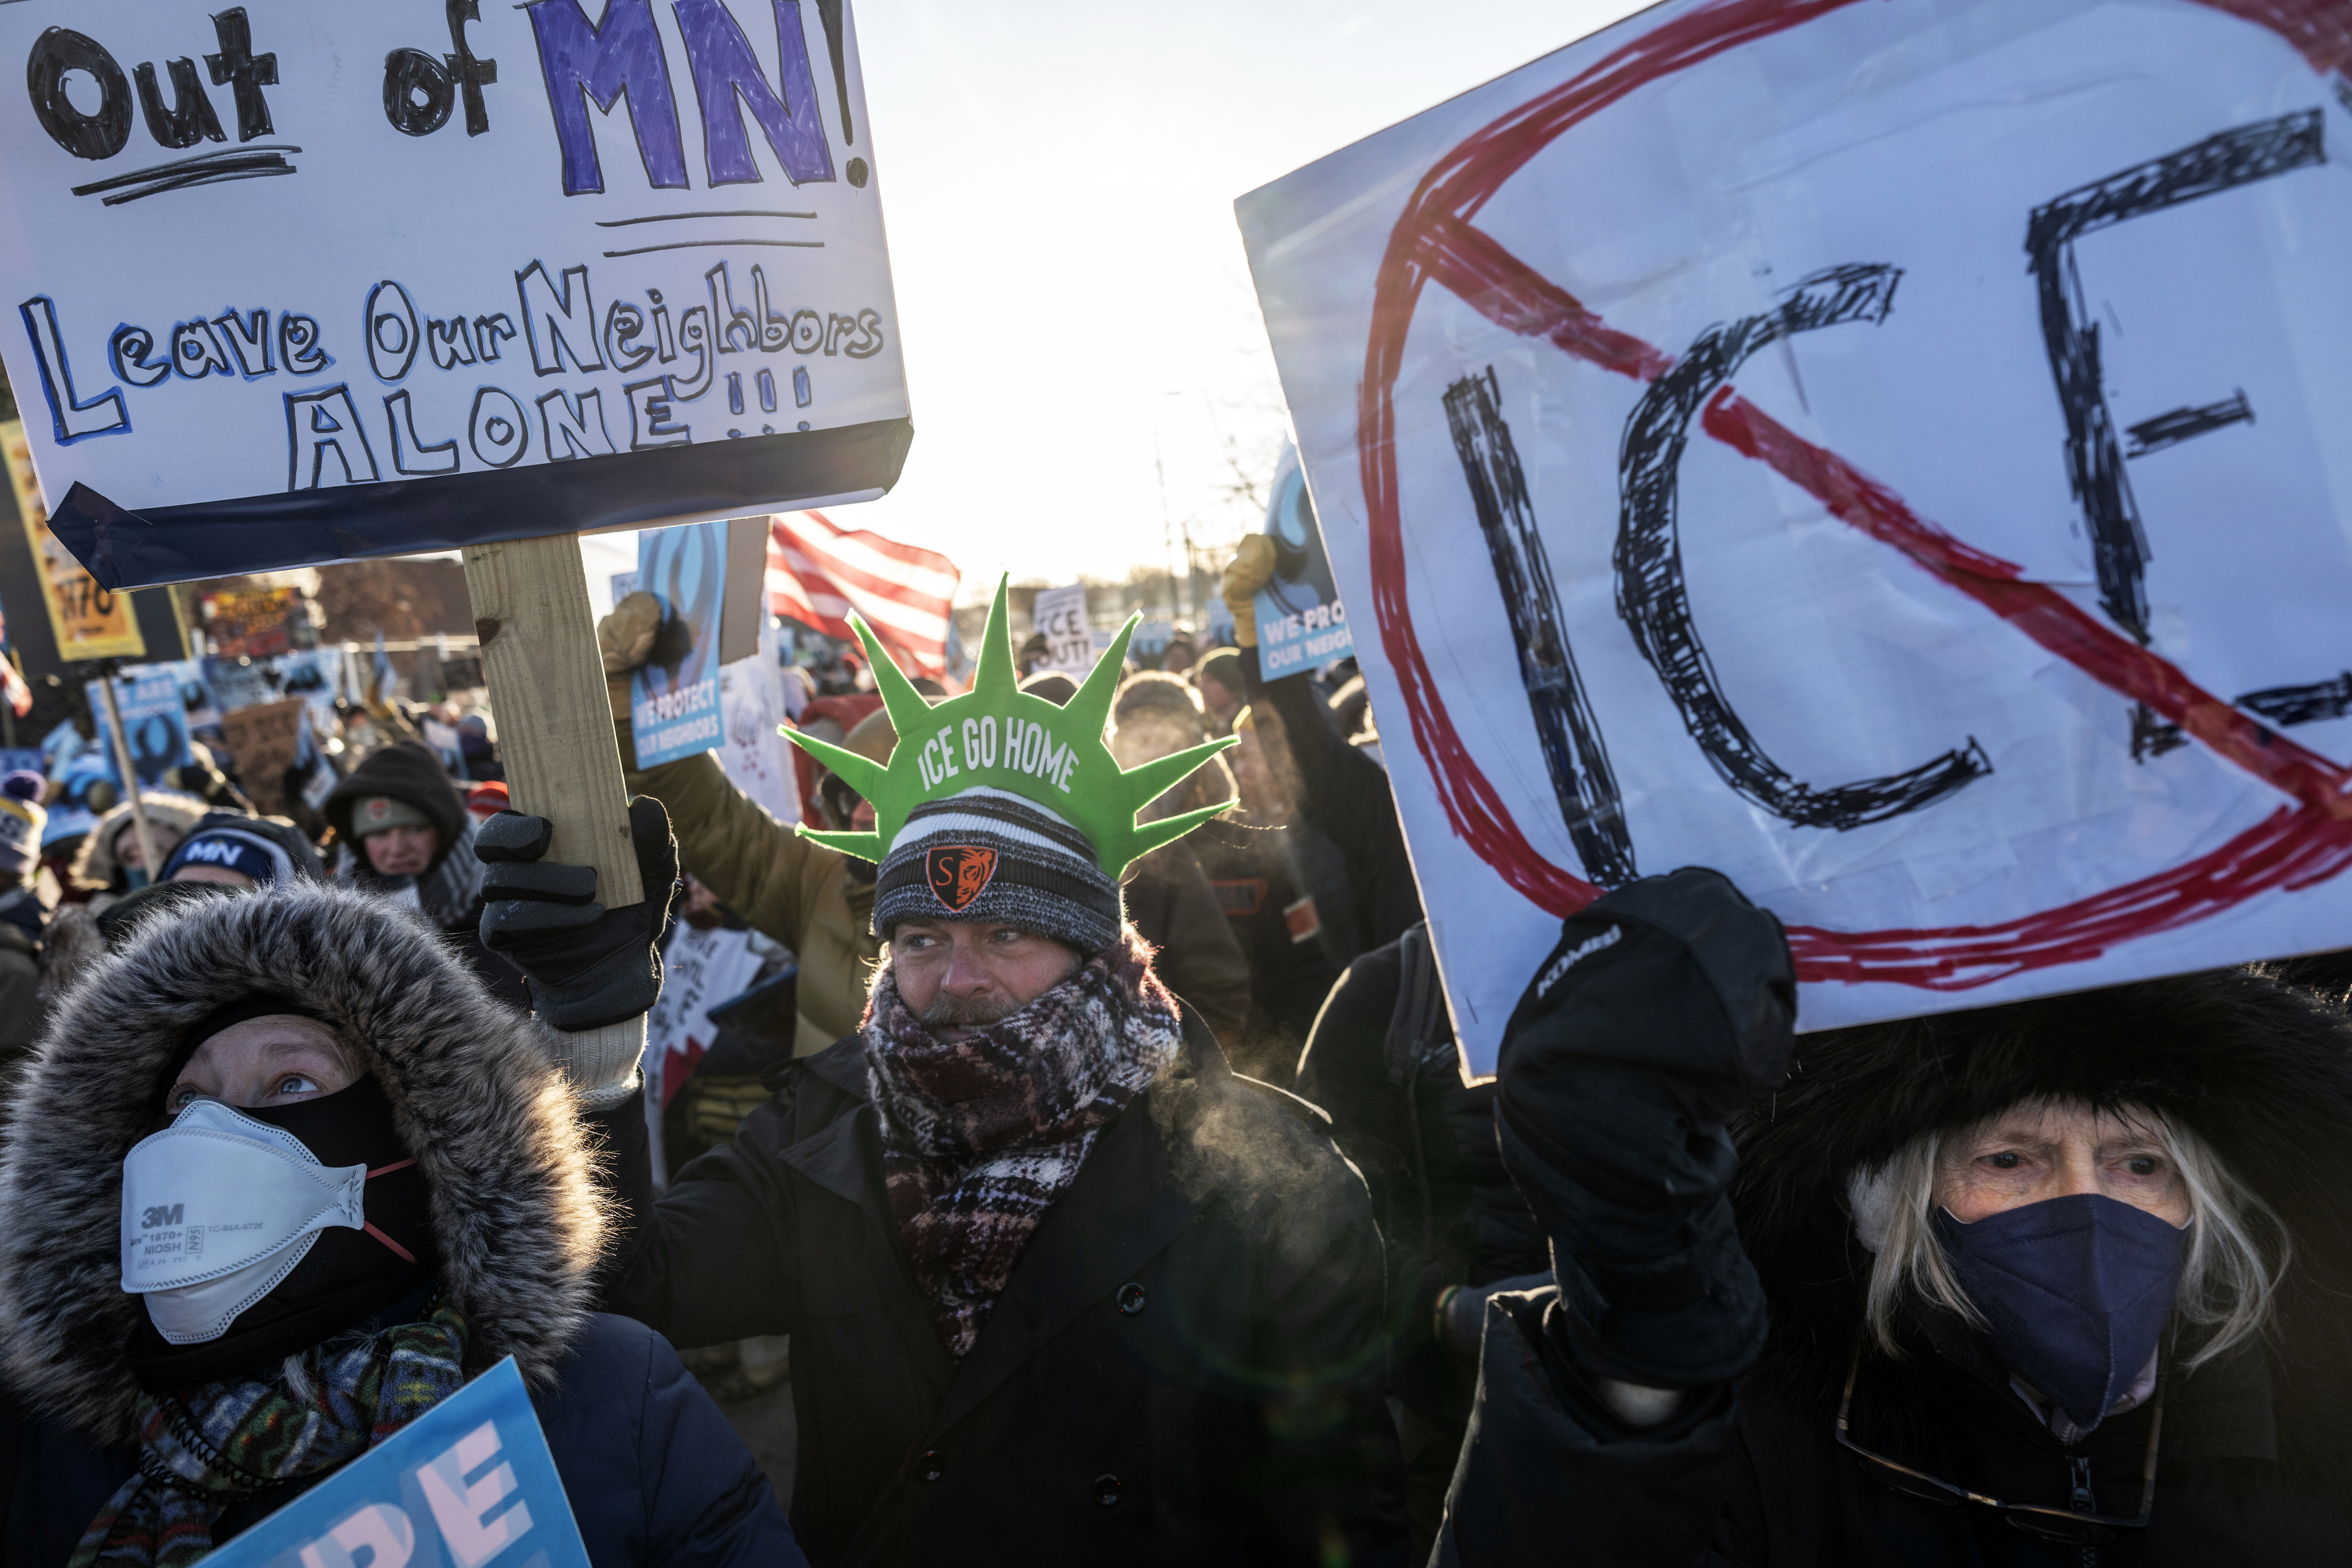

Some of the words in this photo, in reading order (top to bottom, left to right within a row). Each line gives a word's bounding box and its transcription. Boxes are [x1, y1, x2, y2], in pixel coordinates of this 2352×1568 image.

[27, 6, 280, 161] Out
[383, 0, 498, 137] of
[514, 0, 869, 196] MN!
[19, 293, 336, 447] Leave
[365, 279, 517, 386] Our
[514, 258, 884, 400] Neighbors
[1441, 104, 2352, 894] ICE
[1263, 614, 1300, 645] WE
[1303, 599, 1345, 633] PRO
[1049, 639, 1091, 665] UT!
[1267, 644, 1303, 670] OUR
[1305, 629, 1352, 658] NEIG
[656, 678, 716, 724] PROTECT
[657, 714, 720, 751] NEIGHBORS
[917, 725, 960, 792] ICE
[962, 715, 997, 771] GO
[1004, 717, 1080, 794] HOME
[185, 840, 245, 866] MN
[141, 1203, 184, 1229] 3M
[208, 1222, 265, 1233] TC-84A-5726
[144, 1242, 181, 1255] NIOSH
[150, 1232, 183, 1243] 1870+
[188, 1229, 201, 1250] N95
